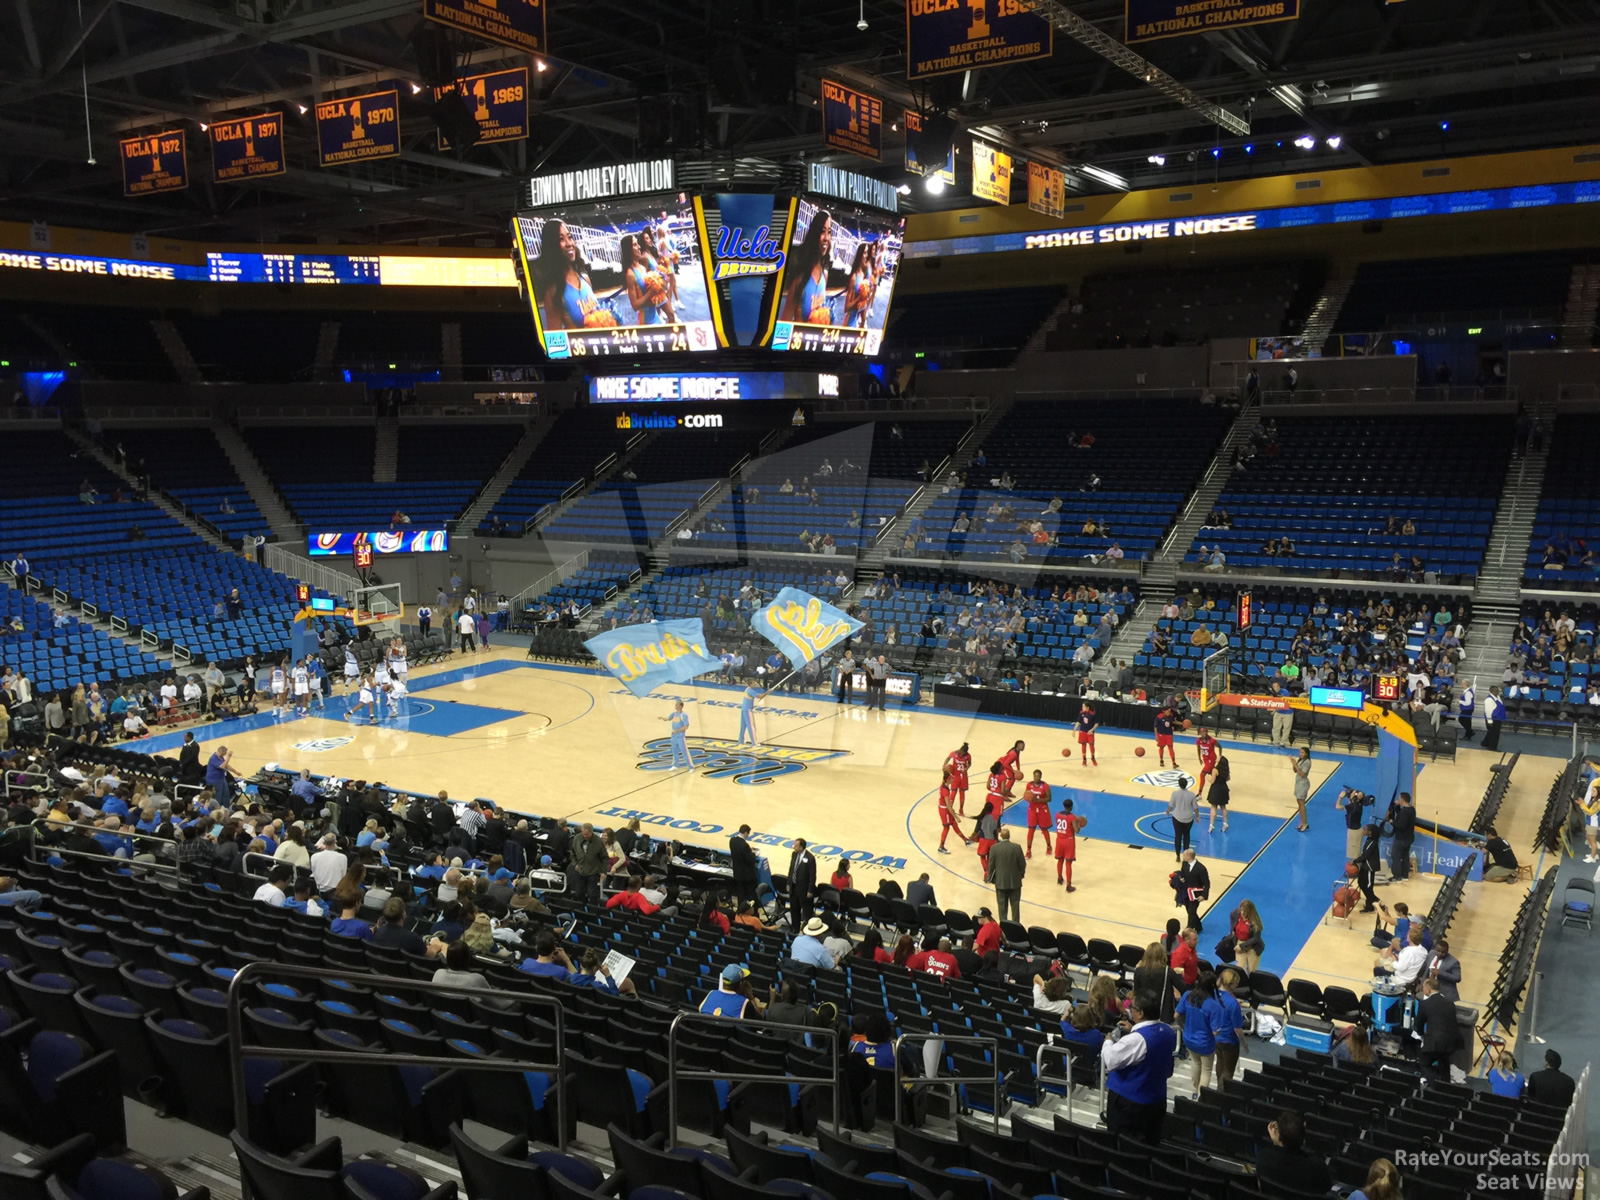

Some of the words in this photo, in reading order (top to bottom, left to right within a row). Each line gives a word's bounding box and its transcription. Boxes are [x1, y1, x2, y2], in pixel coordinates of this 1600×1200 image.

[464, 1, 512, 25] BASKETBALL
[1136, 15, 1202, 36] NATIONAL
[1205, 4, 1285, 25] CHAMPIONS
[435, 3, 484, 29] NATIONAL
[486, 20, 539, 47] CHAMPIONS
[950, 36, 1006, 54] BASKETBALL
[917, 55, 973, 73] NATIONAL
[975, 42, 1041, 63] CHAMPIONS
[493, 86, 524, 105] 1969
[824, 84, 846, 104] UCLA
[317, 103, 346, 120] UCLA
[367, 107, 394, 125] 1970
[214, 124, 243, 142] UCLA
[258, 122, 278, 139] 1971
[125, 140, 151, 158] UCLA
[161, 139, 181, 155] 1972
[325, 148, 357, 162] NATIONAL
[357, 144, 394, 157] CHAMPIONS
[342, 138, 375, 149] BASKETBALL
[218, 166, 246, 179] NATIONAL
[248, 161, 279, 175] CHAMPIONS
[231, 156, 265, 167] BASKETBALL
[531, 174, 563, 206] EDWIN
[563, 171, 574, 202] W
[576, 165, 616, 200] PAULEY
[617, 159, 672, 194] PAVILION
[811, 163, 838, 197] EDWIN
[839, 169, 847, 199] W
[848, 172, 873, 205] PAULEY
[874, 179, 898, 213] PAVILION
[1025, 230, 1094, 249] MAKE
[1098, 222, 1170, 243] SOME
[1174, 215, 1257, 236] NOISE
[716, 225, 783, 259] Ucla
[45, 257, 108, 274] SOME
[111, 263, 176, 280] NOISE
[717, 262, 777, 278] BRUINS
[571, 338, 586, 356] 36
[670, 333, 687, 351] 24
[612, 329, 639, 345] 2:14
[791, 332, 803, 350] 36
[854, 337, 865, 353] 24
[821, 328, 840, 343] 2:14
[597, 378, 629, 399] MAKE
[630, 377, 680, 400] SOME
[681, 377, 740, 400] NOISE
[358, 552, 370, 565] 30
[1379, 686, 1394, 696] 30
[1380, 677, 1398, 686] 2:13
[990, 777, 998, 788] 33
[595, 806, 724, 834] COURT
[1056, 819, 1067, 830] 20
[1426, 851, 1472, 870] Healt
